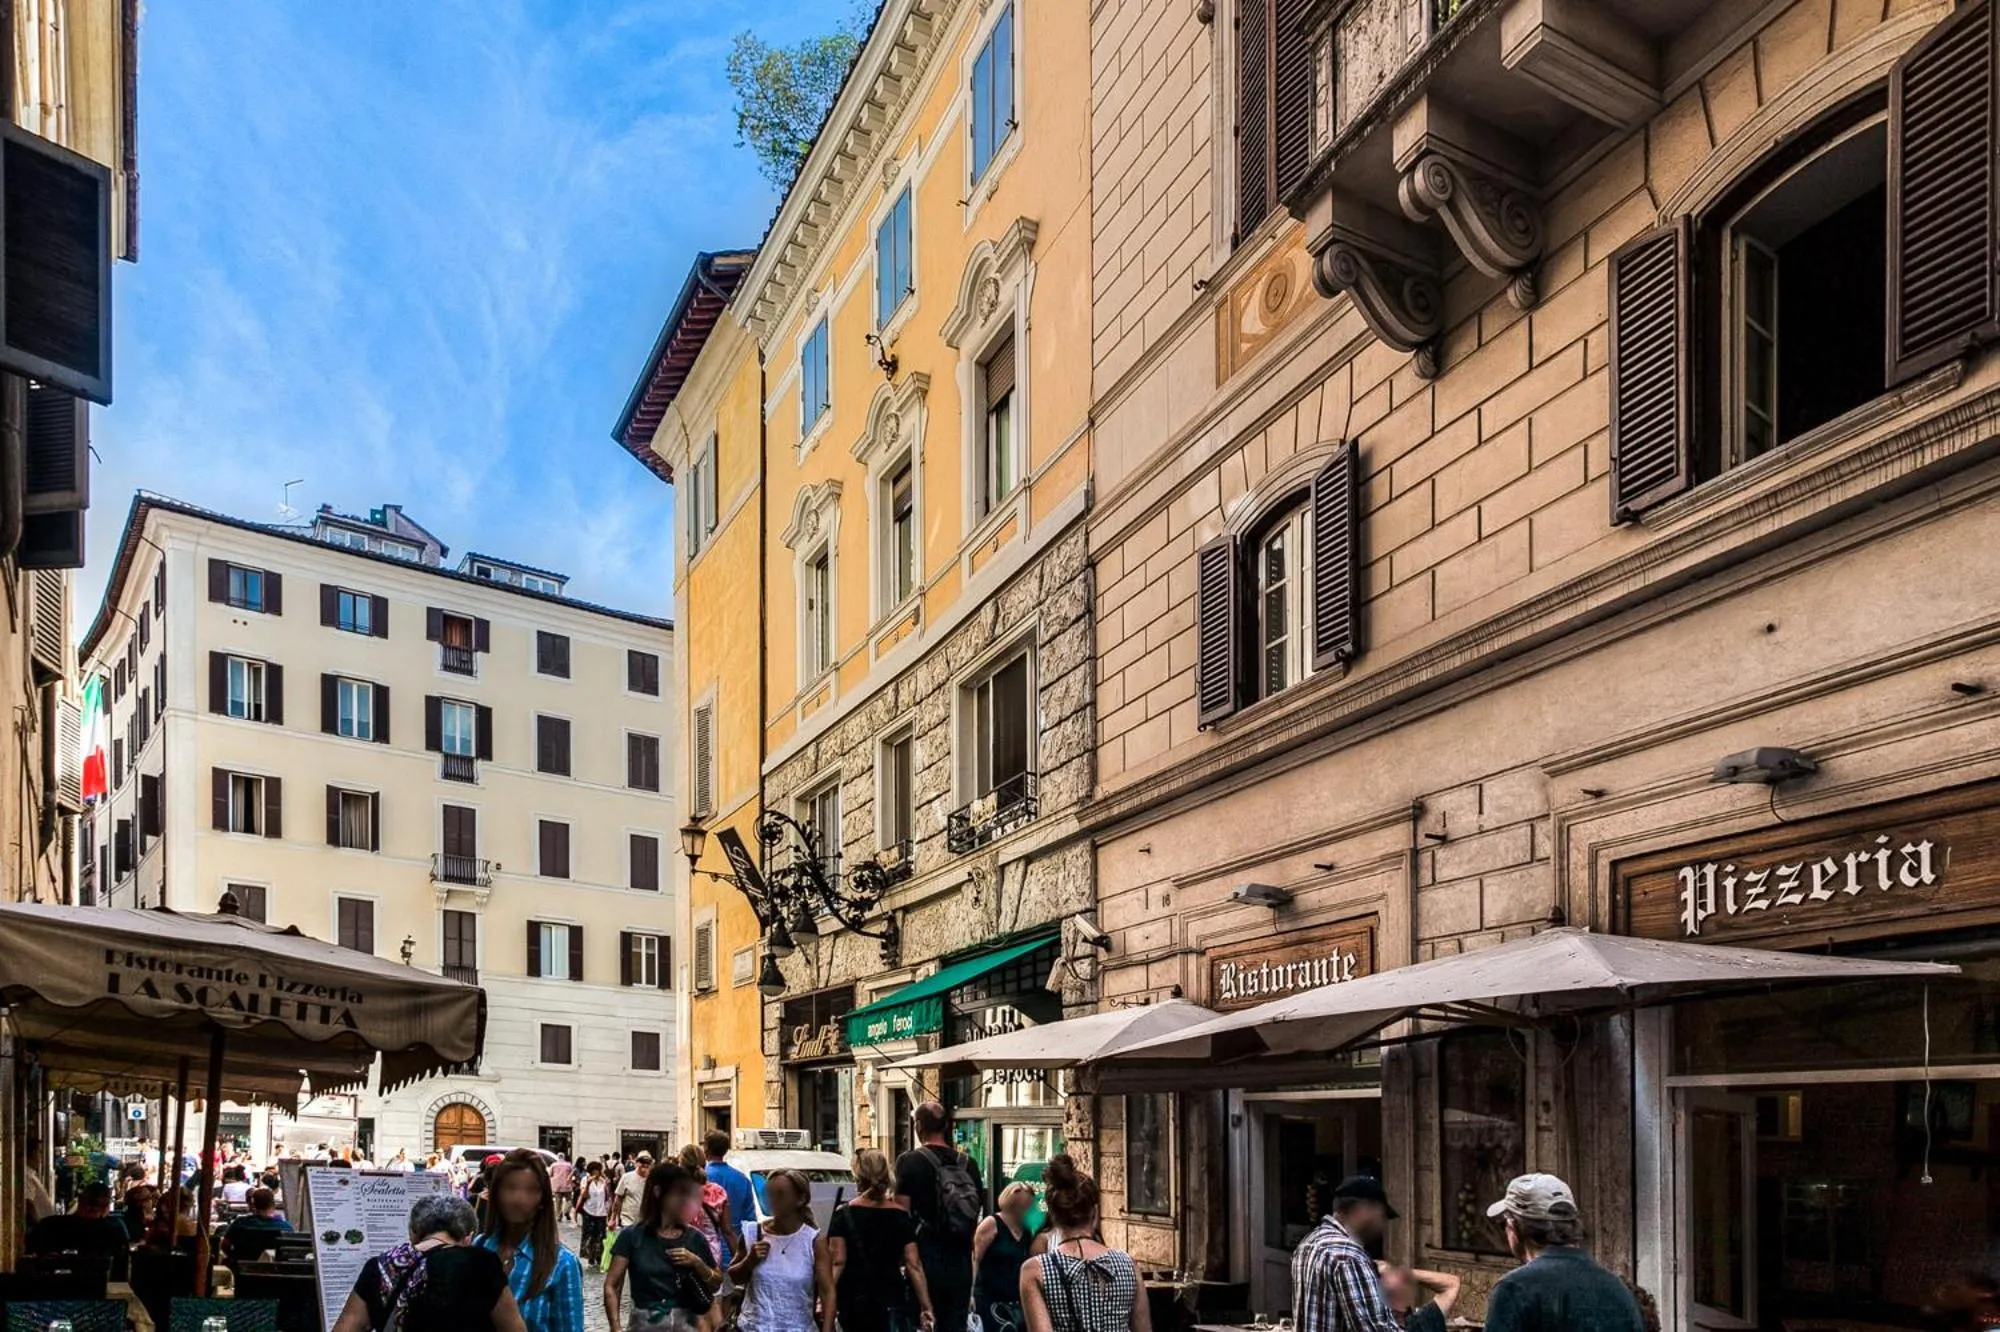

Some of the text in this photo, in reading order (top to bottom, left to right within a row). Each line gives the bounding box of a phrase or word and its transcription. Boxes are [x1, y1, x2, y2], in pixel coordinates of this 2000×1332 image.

[1678, 834, 1937, 936] Pizzeria
[105, 949, 249, 986] Ristorante
[1219, 947, 1356, 1000] Ristorante
[107, 972, 359, 1030] LA SCALETTA
[790, 1023, 831, 1060] Lindt
